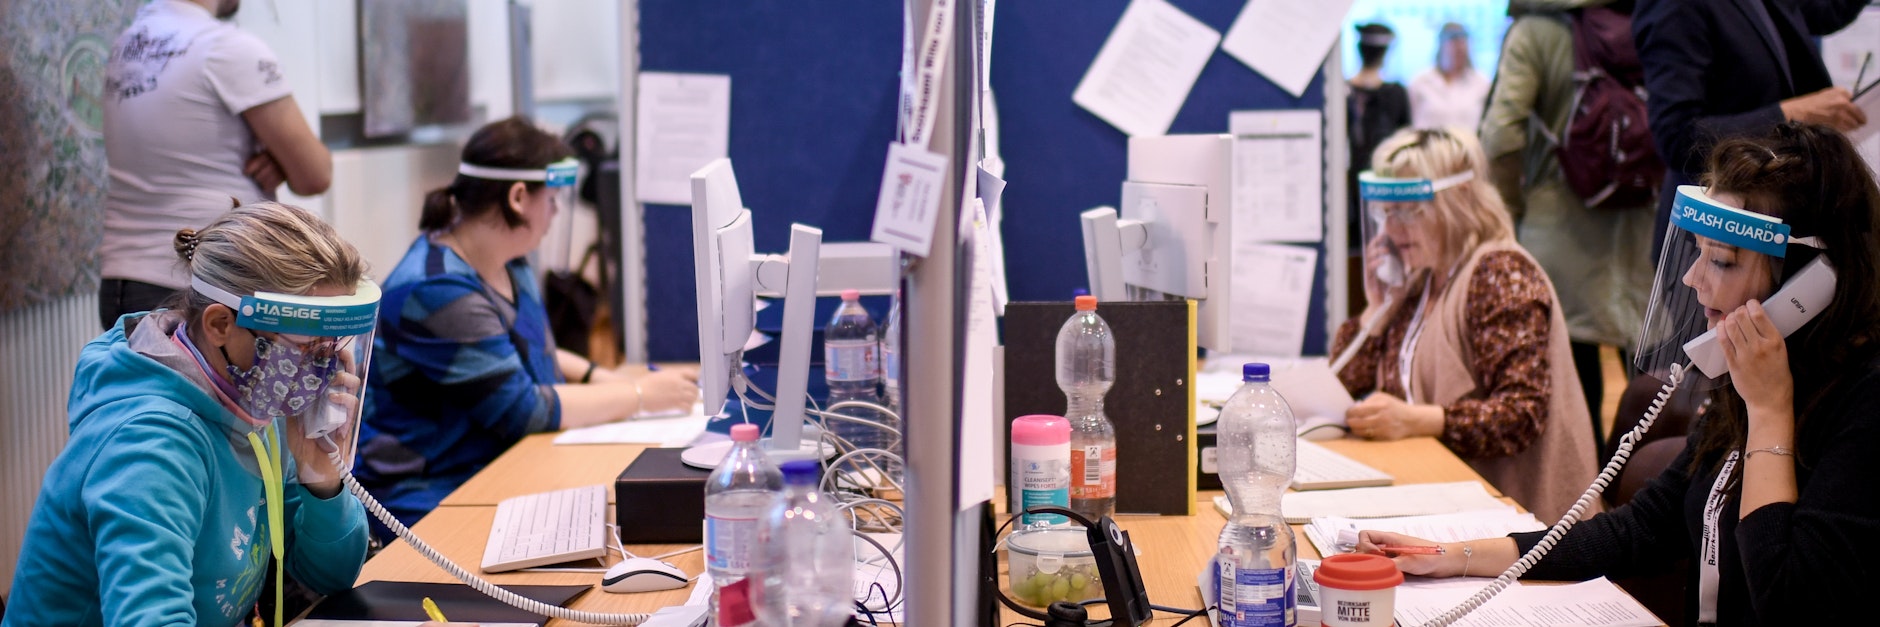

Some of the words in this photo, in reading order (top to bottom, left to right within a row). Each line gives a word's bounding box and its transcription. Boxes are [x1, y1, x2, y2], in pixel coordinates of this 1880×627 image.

[1682, 205, 1724, 230] SPLASH
[1724, 220, 1775, 242] GUARD
[1337, 606, 1370, 616] MITTE
